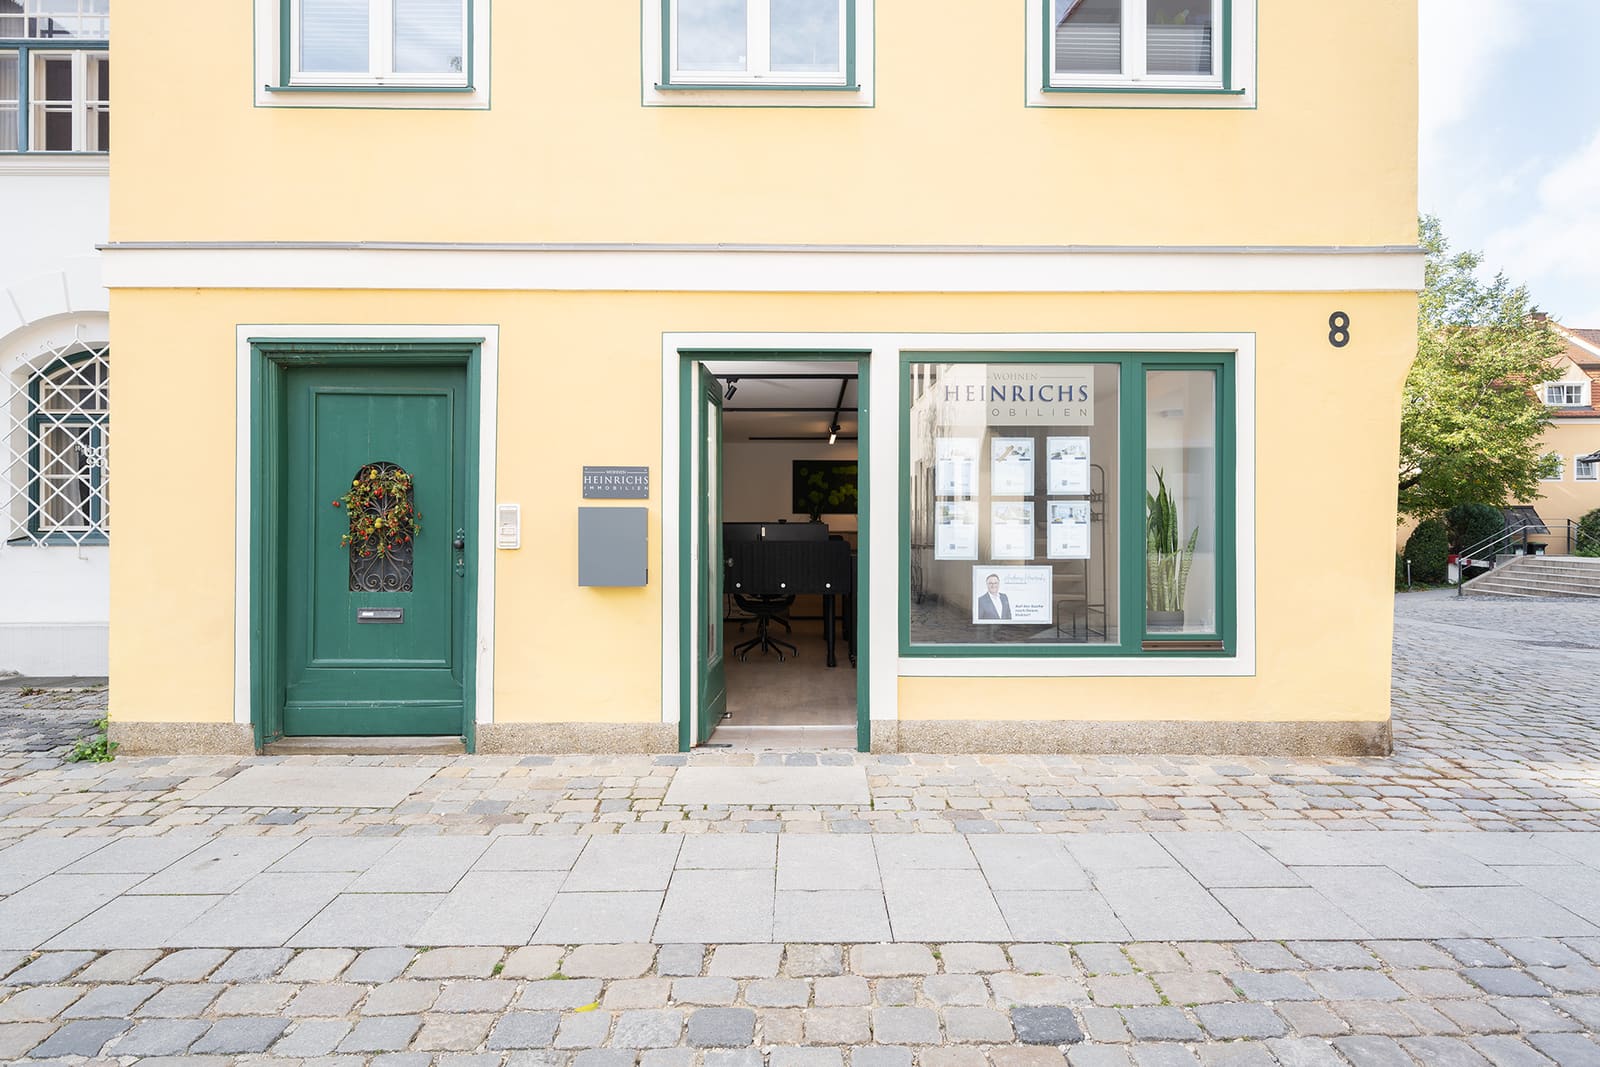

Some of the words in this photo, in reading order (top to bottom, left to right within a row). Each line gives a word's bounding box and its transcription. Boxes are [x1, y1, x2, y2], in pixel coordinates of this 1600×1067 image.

[1329, 311, 1350, 348] 8
[992, 373, 1038, 381] WOHNEN
[944, 385, 1088, 402] HEINRICHS
[991, 408, 1088, 417] OBILIEN
[584, 475, 649, 485] HEINRICHS
